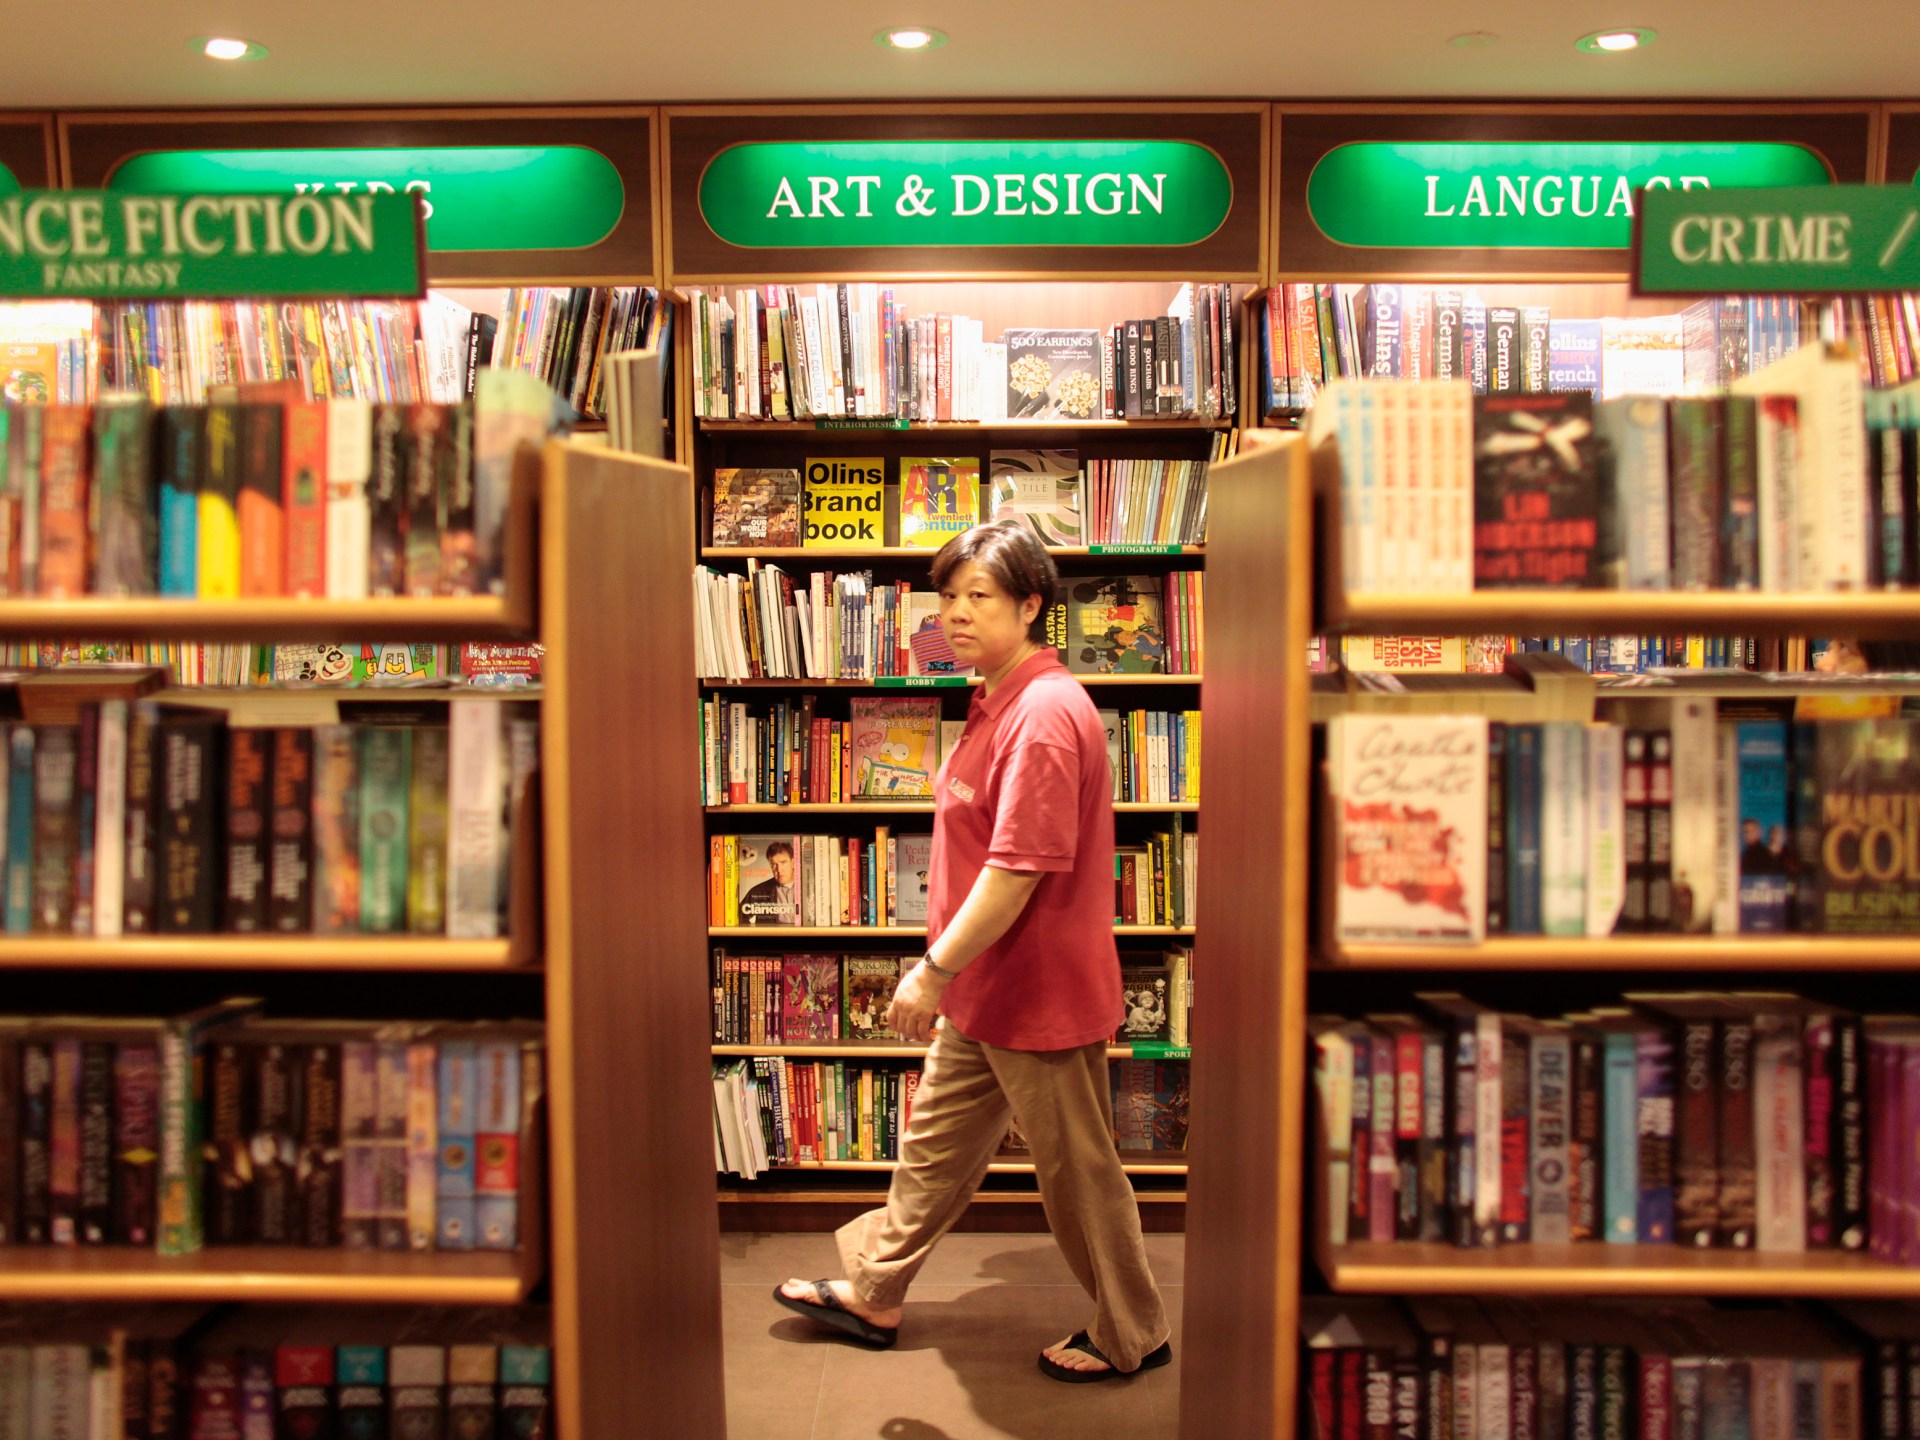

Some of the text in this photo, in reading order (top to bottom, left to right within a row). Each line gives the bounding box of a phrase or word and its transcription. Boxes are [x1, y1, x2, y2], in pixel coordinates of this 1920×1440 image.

[766, 172, 1167, 218] ART & DESIGN
[123, 197, 376, 256] FICTION
[1671, 213, 1852, 265] CRIME
[43, 262, 183, 289] FANTASY
[840, 301, 848, 316] New
[1300, 304, 1316, 334] SAT
[841, 317, 849, 335] Asian
[1375, 286, 1399, 373] Collins
[1011, 337, 1093, 349] 500 EARRINGS
[1157, 320, 1169, 364] MASTERS
[1274, 330, 1283, 361] Italian
[1439, 310, 1456, 384] German
[1550, 333, 1597, 350] ollins
[1879, 316, 1895, 370] WHISKY
[1143, 348, 1151, 362] 500
[1464, 341, 1473, 380] Thesaur
[1471, 329, 1484, 388] Dictionary
[1498, 325, 1513, 391] German
[1530, 327, 1546, 391] German
[1550, 351, 1597, 364] OBERT
[1105, 345, 1113, 390] ANTIQUES
[1550, 365, 1597, 382] rench
[1551, 385, 1597, 398] ctionary
[808, 462, 882, 484] Olins
[902, 466, 980, 514] ART
[1022, 484, 1048, 492] TILE
[804, 491, 881, 512] Brand
[804, 518, 875, 540] book
[919, 520, 975, 532] entury
[1102, 546, 1169, 554] PHOTOGRAPHY
[1046, 605, 1056, 645] CASTAF
[1057, 604, 1067, 650] EMERALD
[490, 646, 538, 658] MONSTER
[906, 678, 936, 686] HOBBY
[868, 720, 920, 729] FOREVER
[905, 844, 930, 855] Peda
[1823, 823, 1920, 881] COL
[1124, 862, 1132, 886] Soddit
[742, 903, 794, 915] Clarkson
[850, 958, 898, 970] SOKORA
[1123, 984, 1160, 992] WARPE
[1124, 976, 1160, 984] STAR
[782, 1090, 790, 1119] SURVIVAL
[1538, 1050, 1564, 1148] DEAVER
[774, 1106, 782, 1130] BIKE
[837, 1111, 845, 1131] SPORT
[1366, 1371, 1391, 1425] FORD
[1397, 1376, 1418, 1439] FURY
